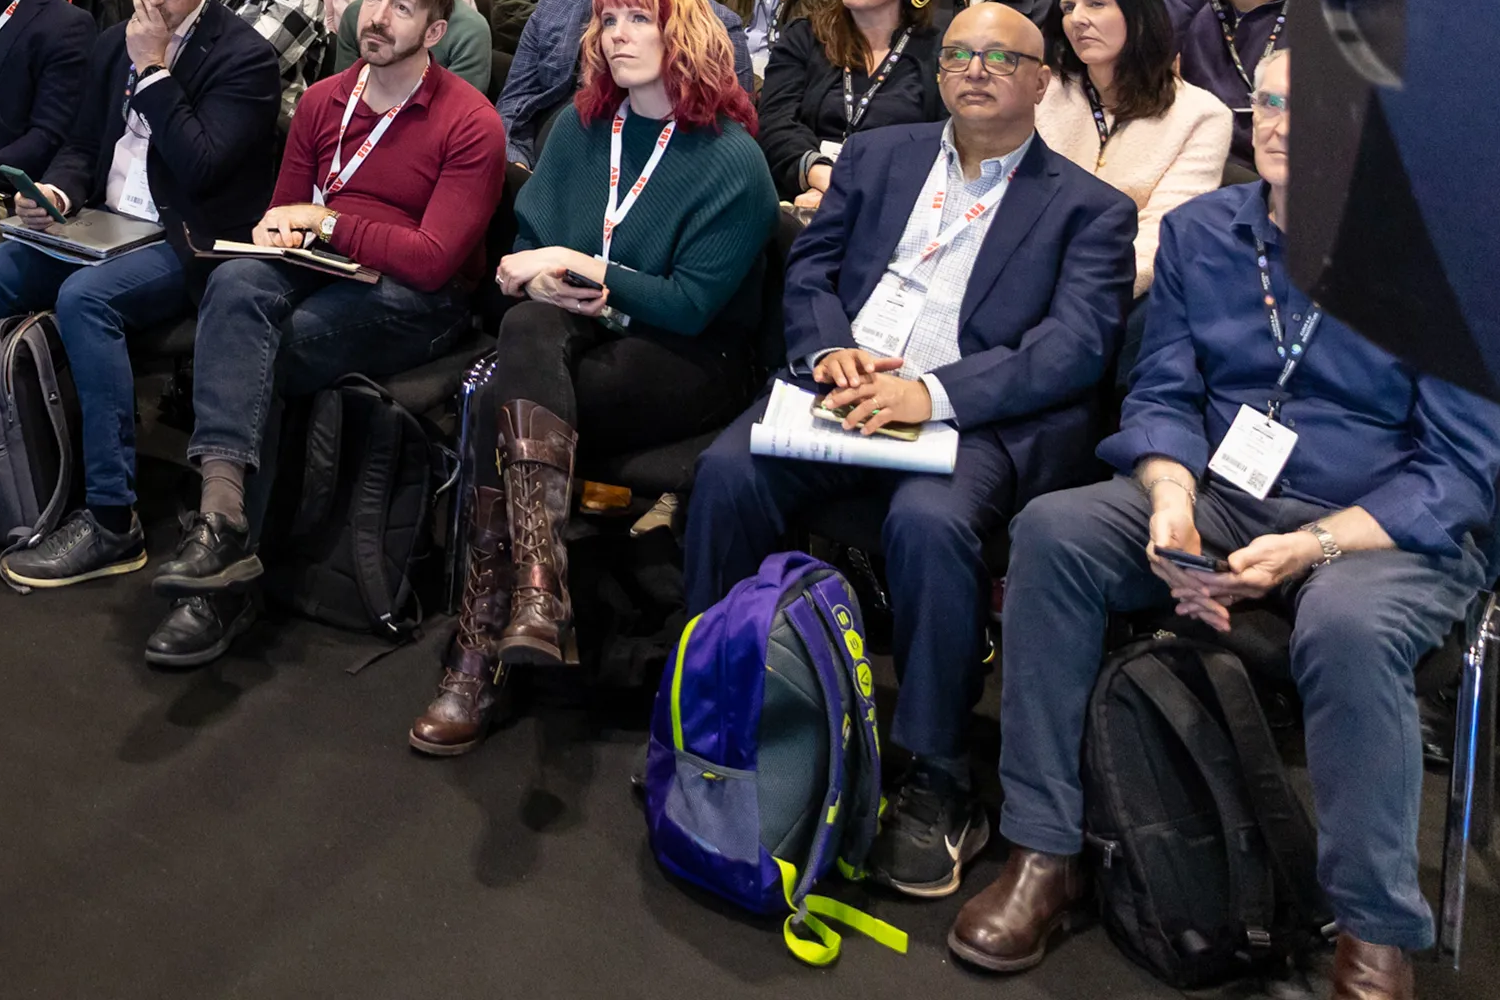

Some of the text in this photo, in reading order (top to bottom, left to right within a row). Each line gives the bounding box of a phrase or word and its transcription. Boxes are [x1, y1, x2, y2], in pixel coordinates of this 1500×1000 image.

[352, 80, 365, 98] ABB
[612, 114, 624, 134] ABB
[658, 127, 672, 149] ABB
[357, 140, 373, 159] ABB
[610, 166, 619, 187] ABB
[631, 176, 647, 196] ABB
[964, 202, 986, 223] ABB
